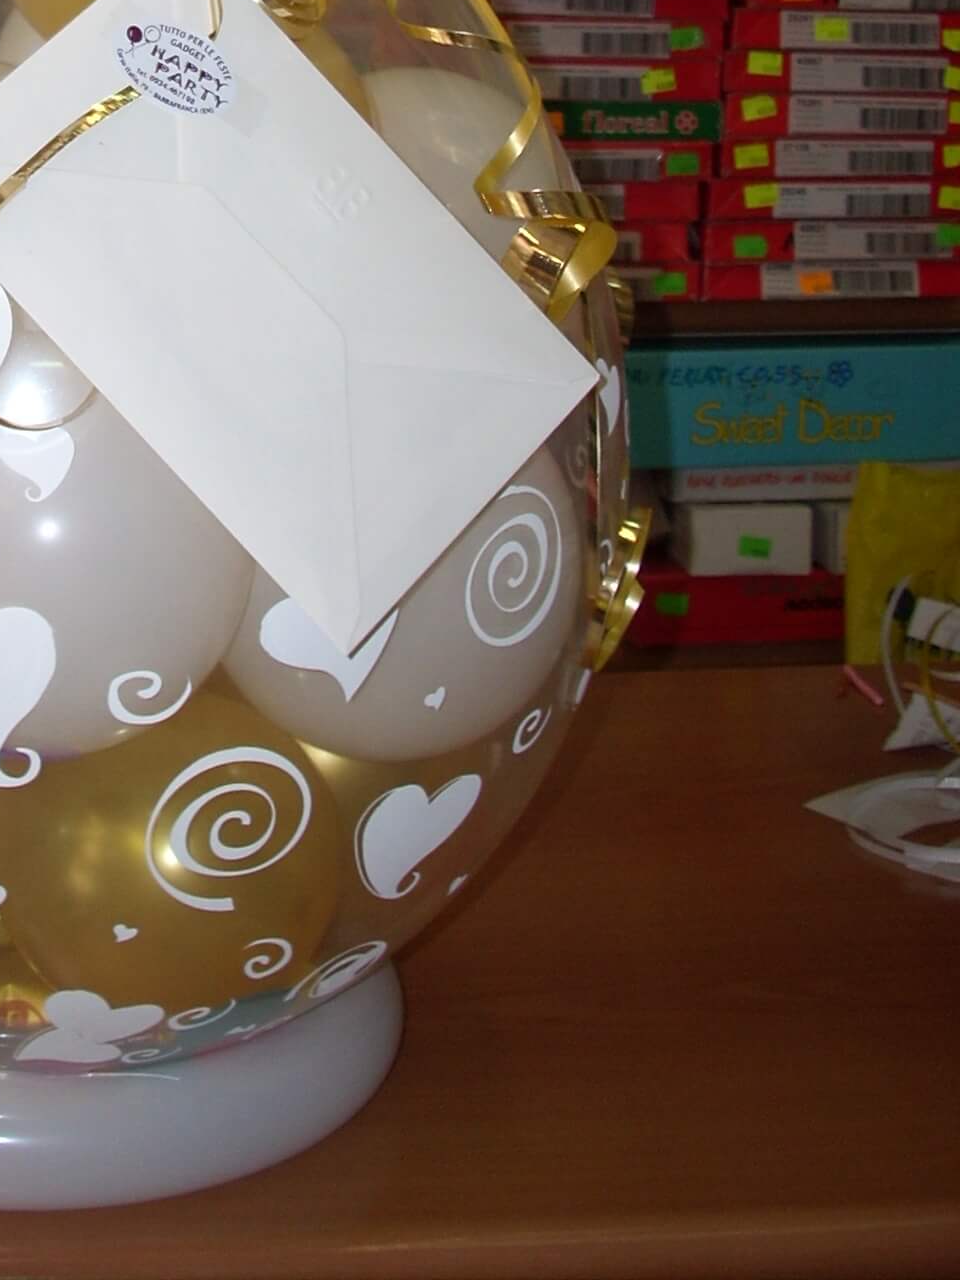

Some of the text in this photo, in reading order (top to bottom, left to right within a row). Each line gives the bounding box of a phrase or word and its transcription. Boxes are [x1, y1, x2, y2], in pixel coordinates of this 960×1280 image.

[160, 24, 187, 39] TUTTO
[187, 34, 204, 47] PER
[170, 38, 206, 62] GADGET
[150, 45, 228, 91] HAPPY
[155, 62, 228, 108] PARTY
[691, 396, 897, 446] Sweet Decor
